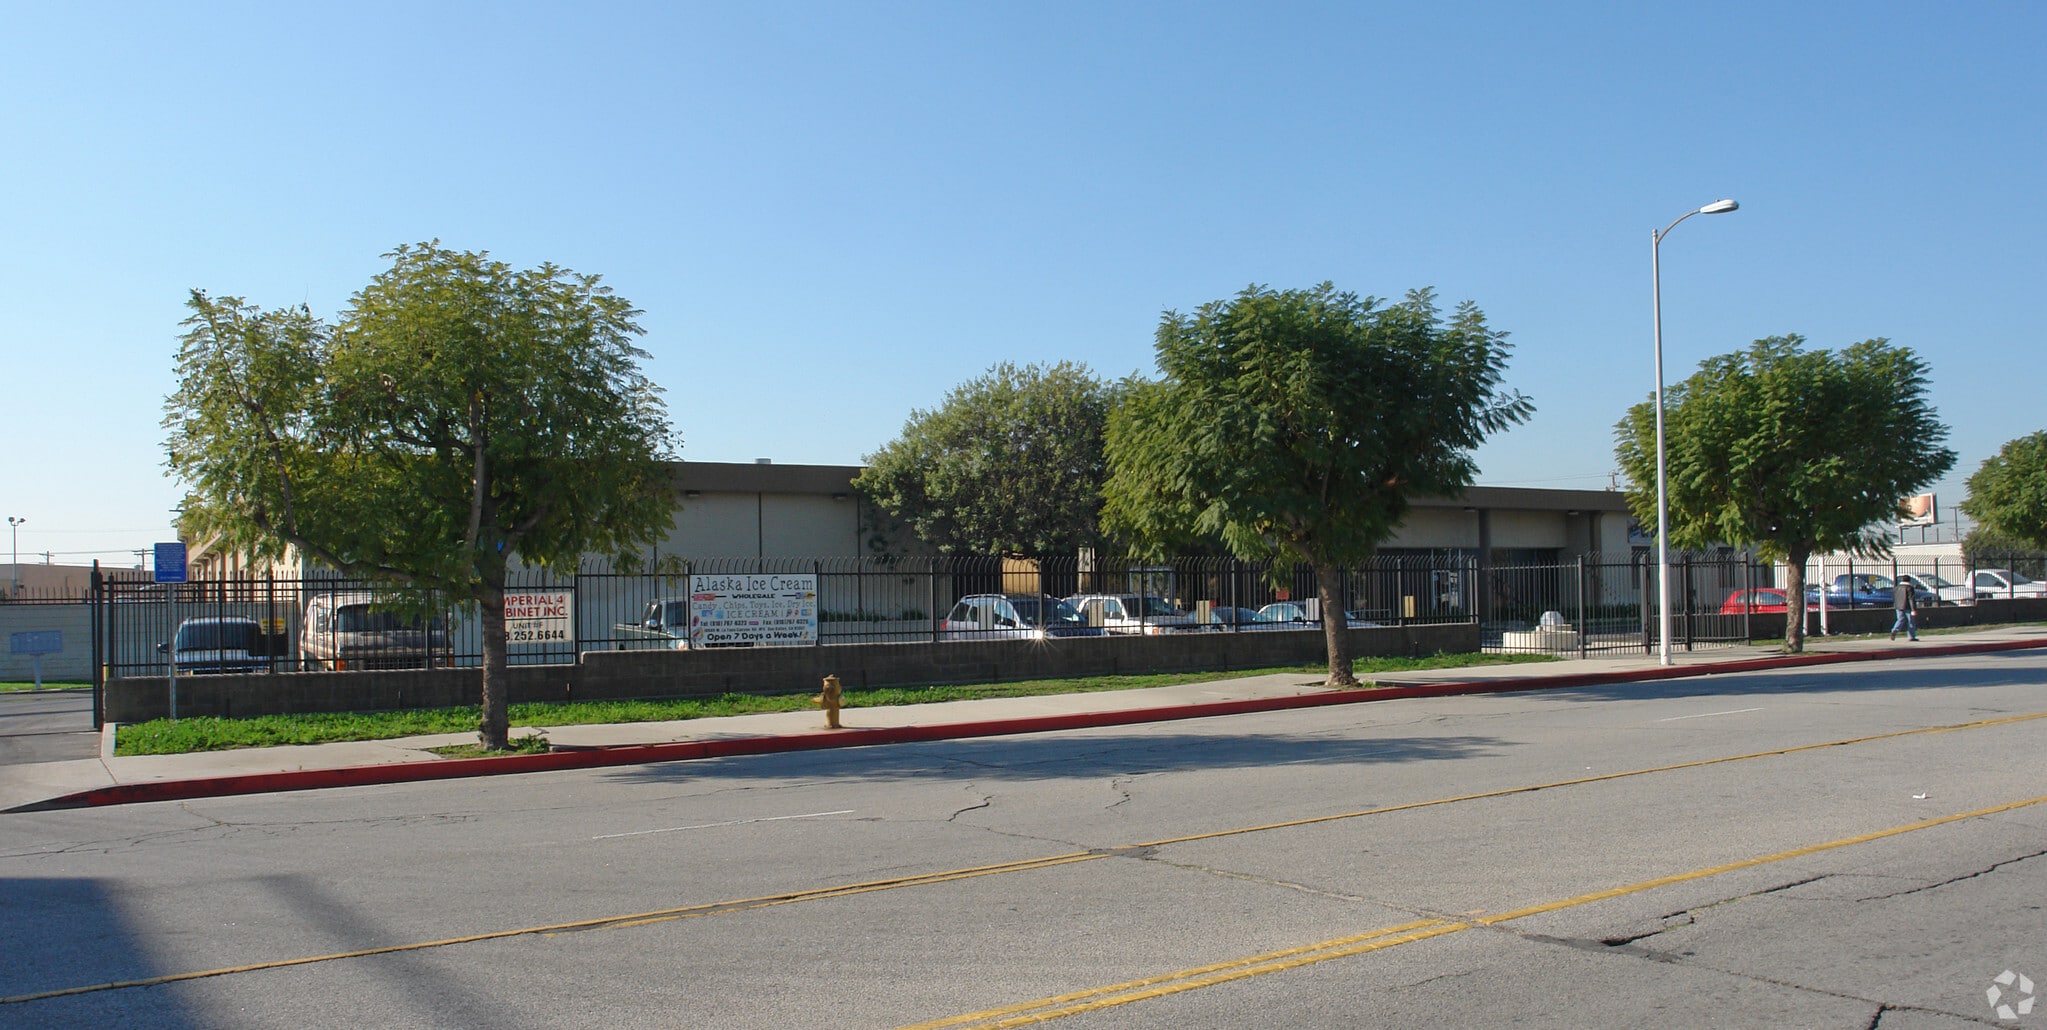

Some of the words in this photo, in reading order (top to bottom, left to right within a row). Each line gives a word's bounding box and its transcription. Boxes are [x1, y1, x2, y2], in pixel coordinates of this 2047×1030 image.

[695, 577, 742, 592] Alaska
[746, 576, 766, 591] Ice
[770, 576, 813, 591] Cream
[504, 595, 553, 606] MPERIAL
[555, 595, 563, 604] 4
[505, 607, 541, 618] BINET
[543, 606, 568, 617] INC.
[727, 610, 743, 619] ICE
[512, 622, 531, 630] UNIT
[505, 630, 564, 641] 8.252.6644
[707, 633, 732, 641] Open
[742, 632, 763, 641] Days
